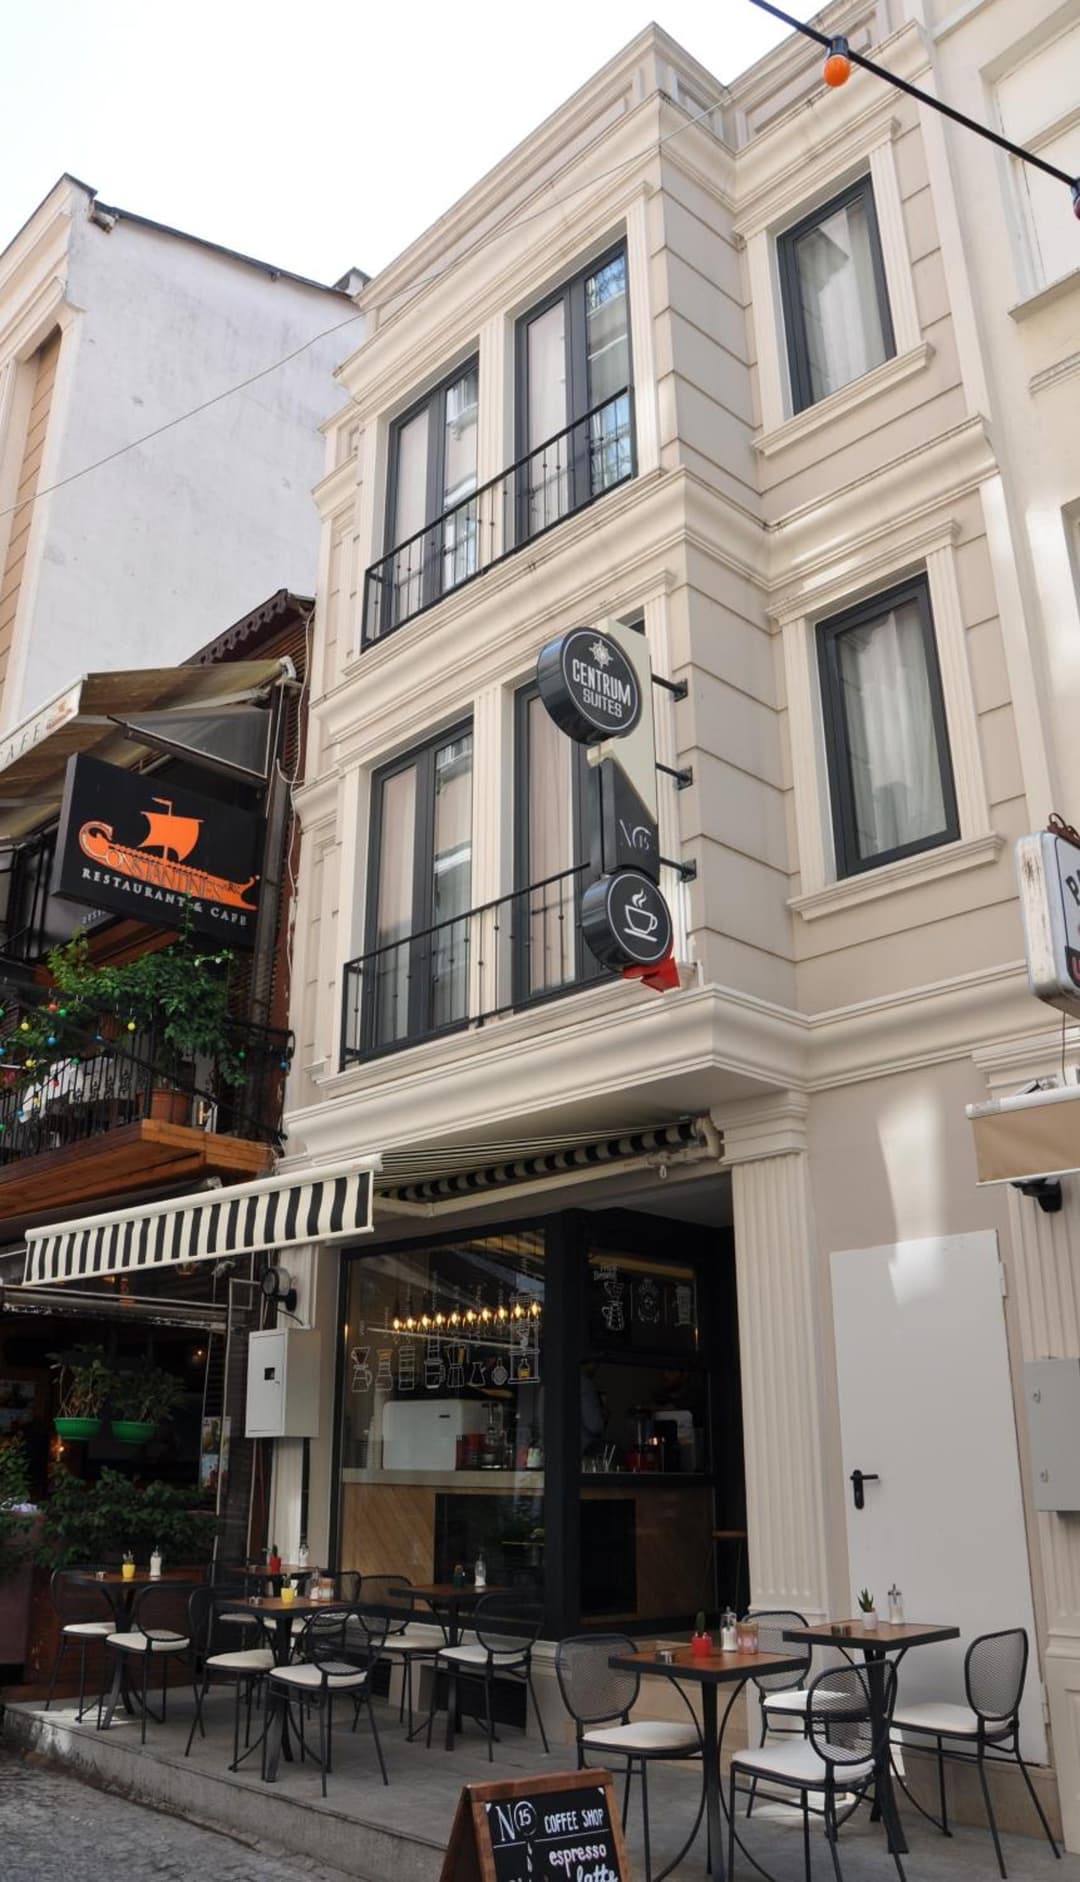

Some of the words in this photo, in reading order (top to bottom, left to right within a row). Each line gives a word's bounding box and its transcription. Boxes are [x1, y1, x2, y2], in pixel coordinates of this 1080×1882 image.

[572, 658, 631, 706] CENTRUM
[582, 688, 622, 718] SUITES
[82, 867, 187, 910] RESTAURANT
[192, 901, 204, 914] &
[210, 905, 248, 926] CAFE
[544, 1810, 579, 1834] COFFEE
[581, 1808, 604, 1828] SHOP
[548, 1843, 608, 1879] espresso
